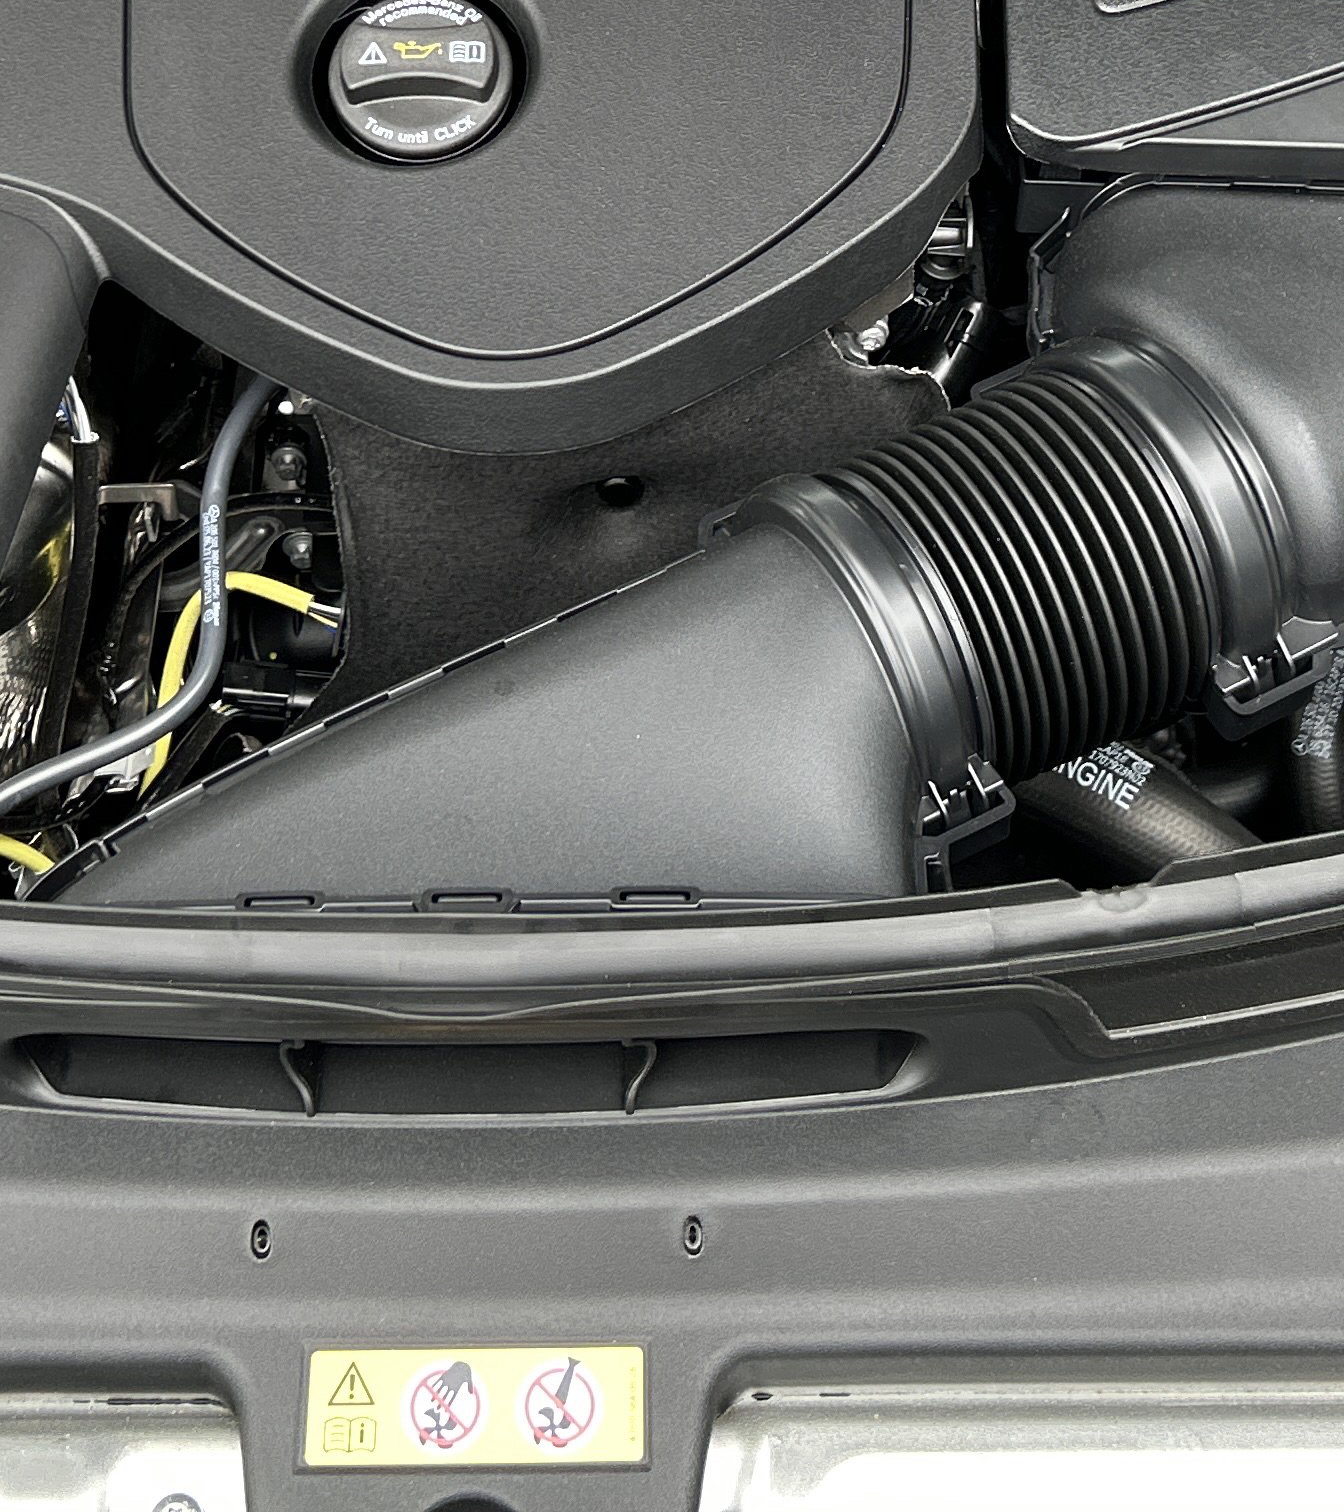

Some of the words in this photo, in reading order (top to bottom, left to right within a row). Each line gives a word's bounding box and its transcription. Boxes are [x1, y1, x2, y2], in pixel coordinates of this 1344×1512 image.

[379, 5, 468, 27] recommended
[365, 116, 394, 140] Turn
[398, 130, 429, 144] until
[434, 114, 477, 141] CLICK
